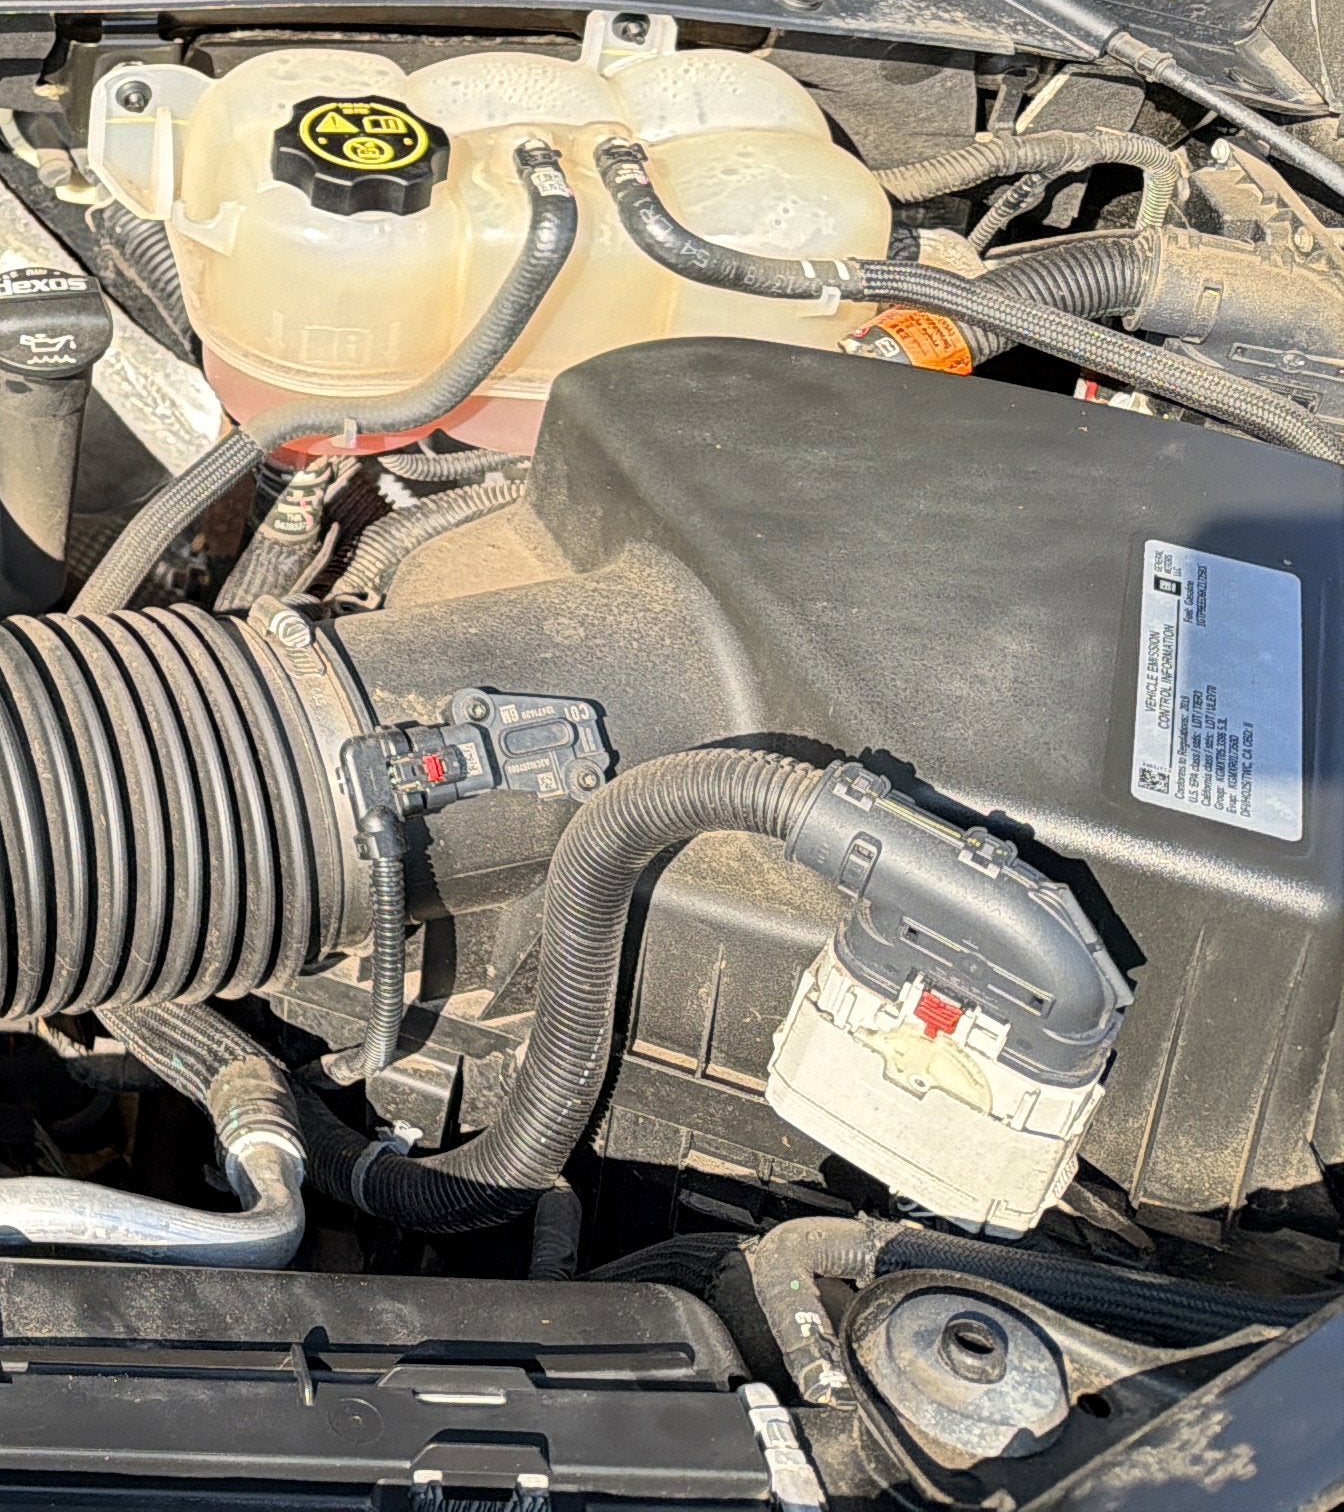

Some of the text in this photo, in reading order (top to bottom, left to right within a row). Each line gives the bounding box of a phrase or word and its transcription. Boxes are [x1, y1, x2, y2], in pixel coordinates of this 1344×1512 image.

[1145, 630, 1160, 712] VEHICLE EMISSION
[1158, 624, 1174, 729] CONTROL INFORMATION
[1189, 772, 1199, 787] EPA
